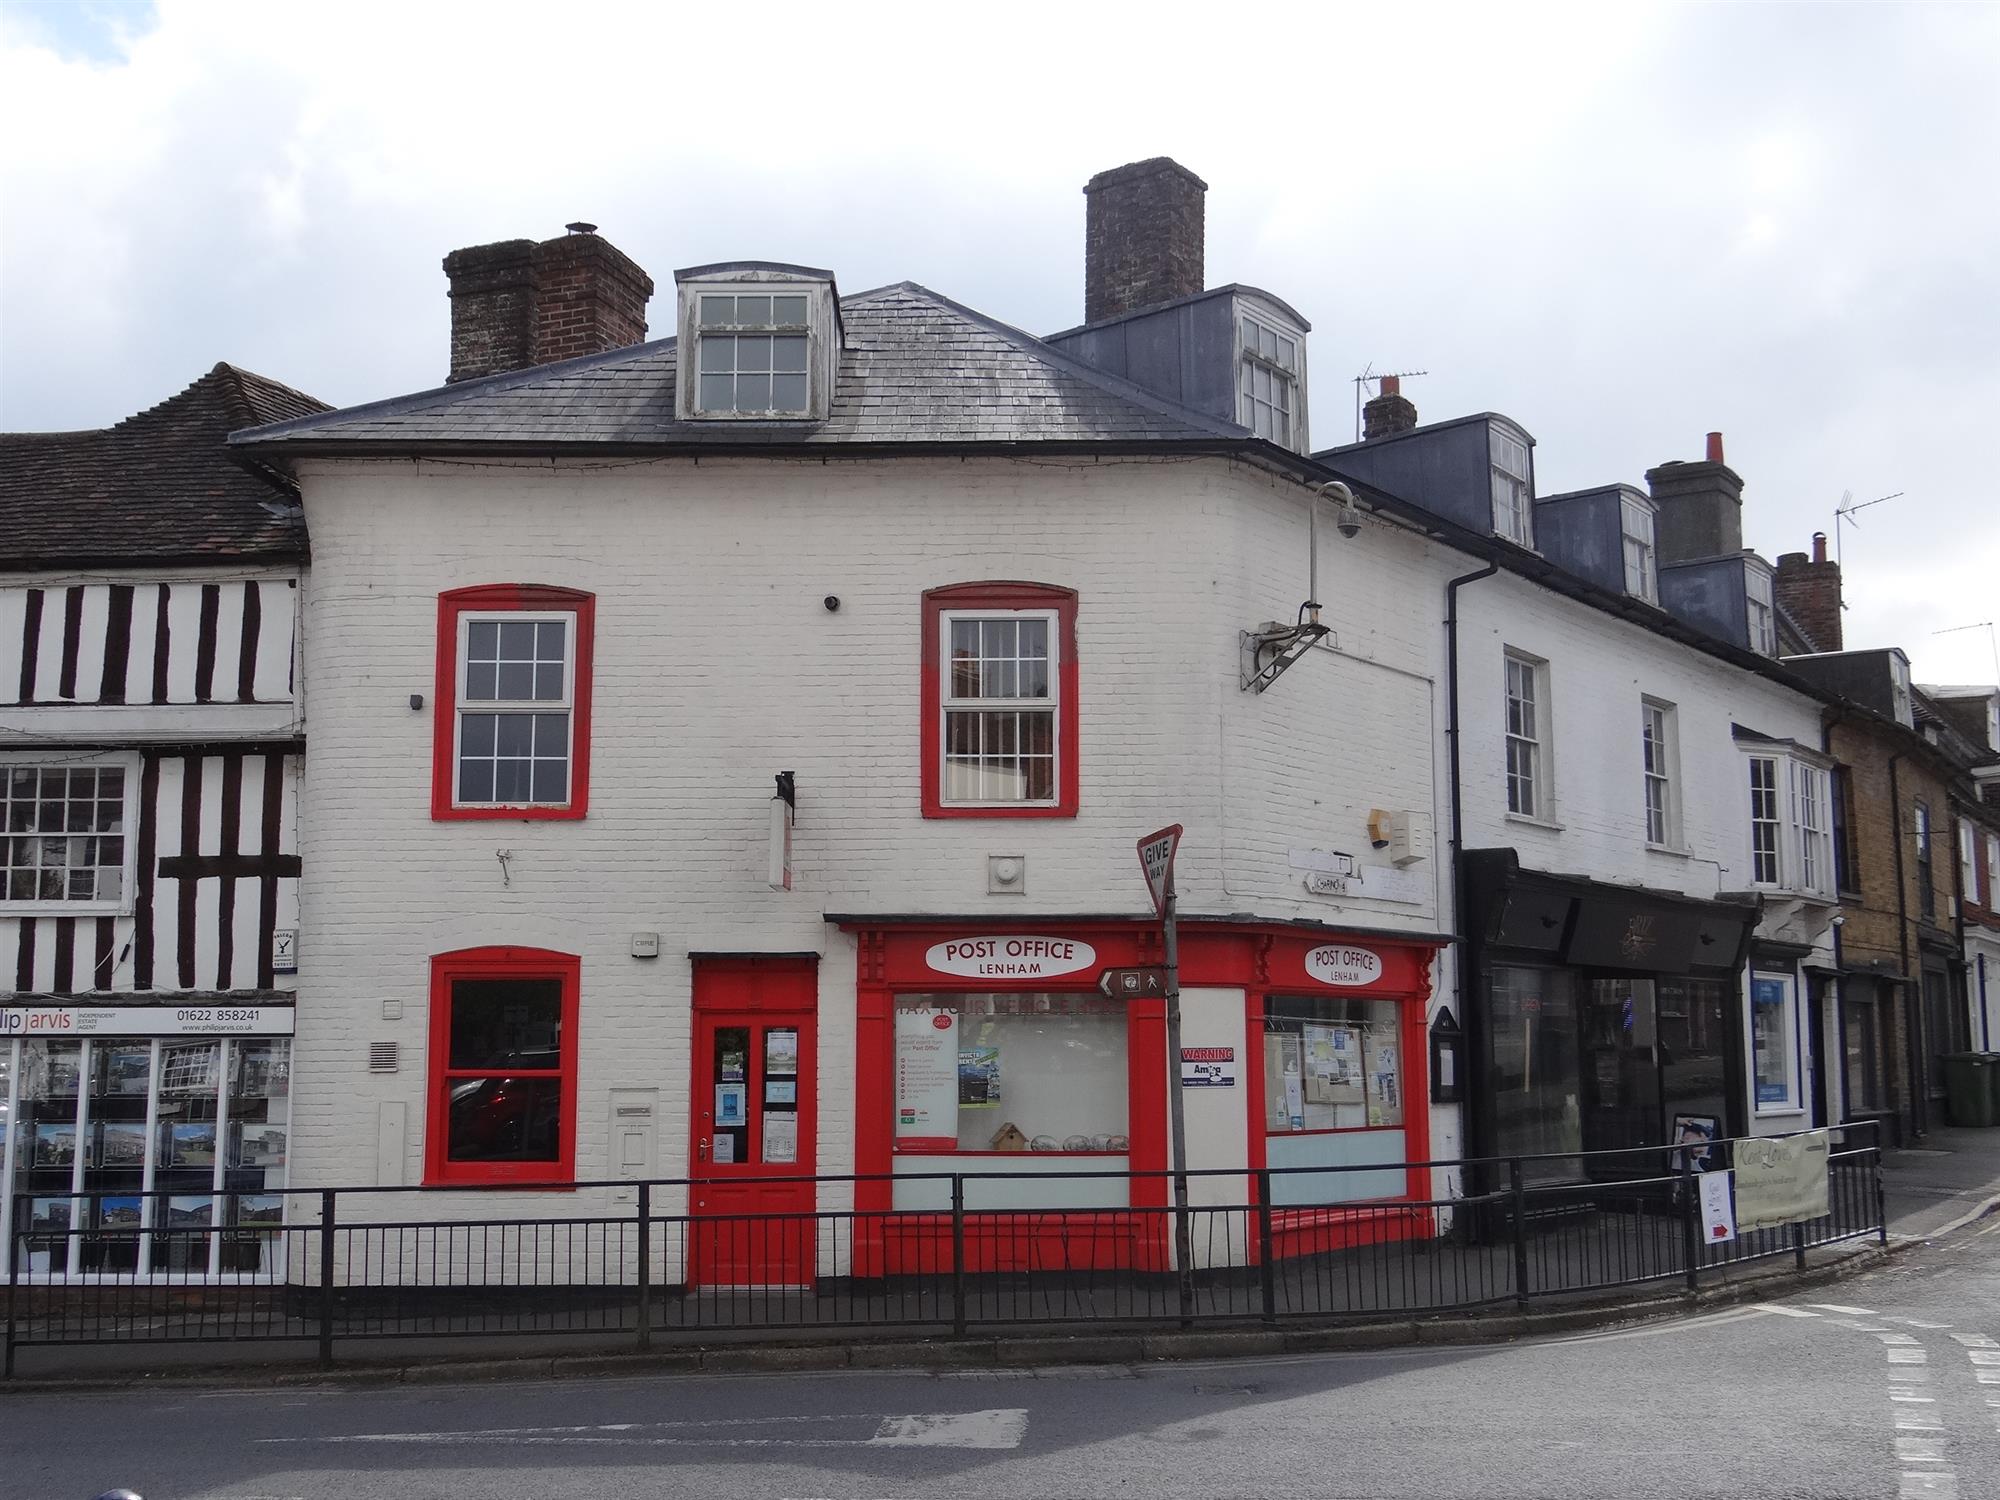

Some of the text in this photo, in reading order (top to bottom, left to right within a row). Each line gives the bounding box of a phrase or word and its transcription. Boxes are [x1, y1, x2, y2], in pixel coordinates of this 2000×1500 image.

[1145, 840, 1169, 865] GIVE
[1149, 864, 1166, 880] WAY
[946, 940, 1074, 961] POST OFFICE
[1315, 950, 1374, 971] POST OFFICE
[979, 963, 1041, 974] LENHAM
[1330, 971, 1360, 982] LENHAM
[23, 1008, 71, 1034] jarvis
[177, 1010, 260, 1021] 01622 858241
[182, 1024, 253, 1032] www.philipjarvis.co.uk
[1183, 1048, 1233, 1060] WARNING
[1194, 1064, 1221, 1075] Amga
